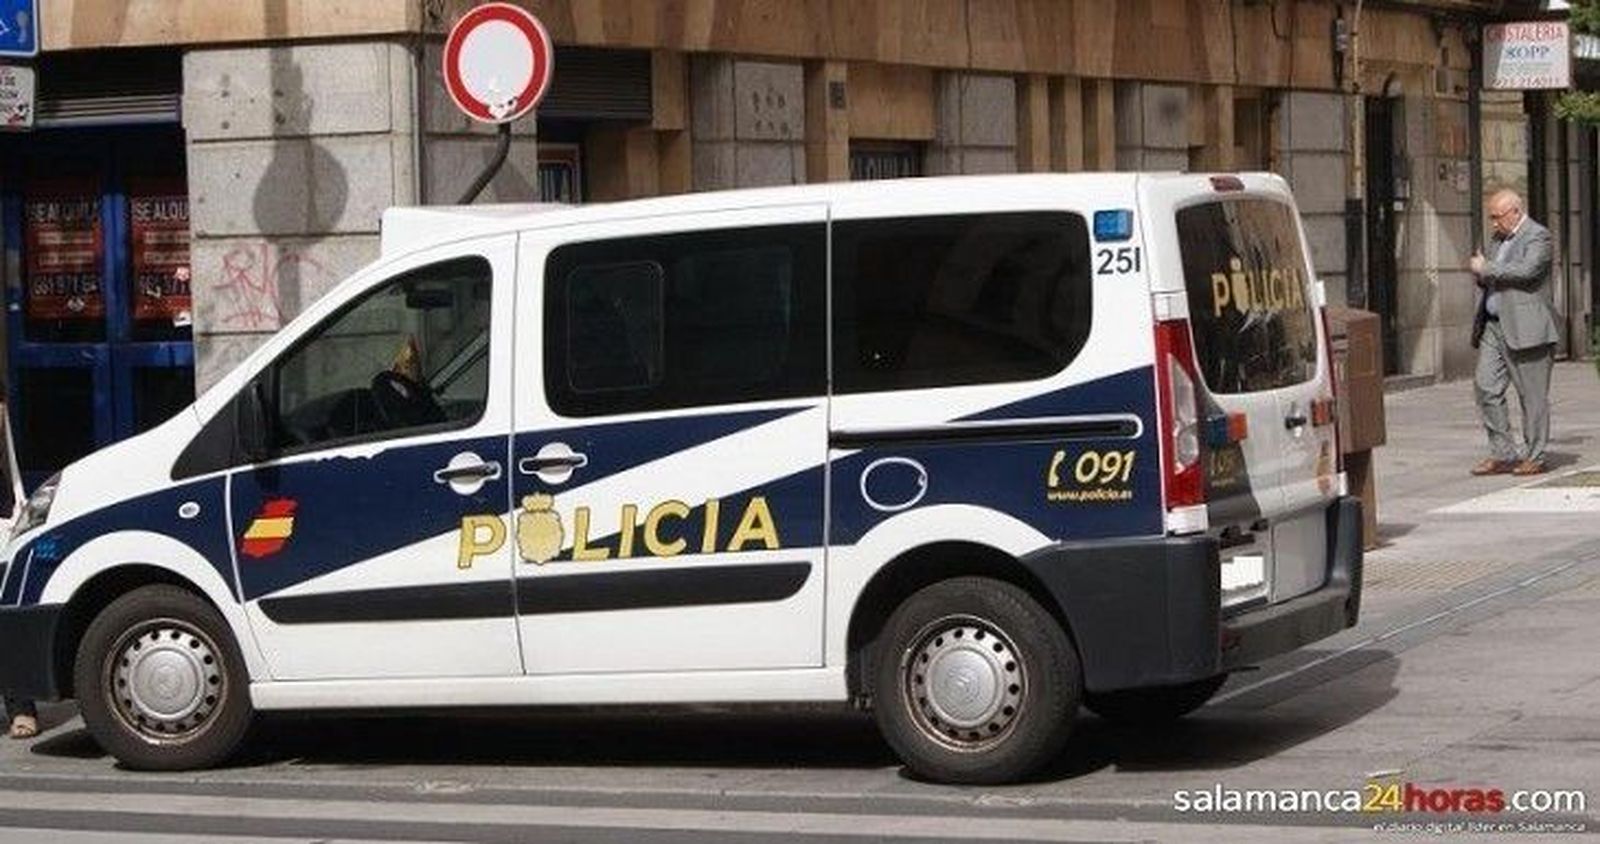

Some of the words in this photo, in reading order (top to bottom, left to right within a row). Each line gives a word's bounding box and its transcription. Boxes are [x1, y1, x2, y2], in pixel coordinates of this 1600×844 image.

[1211, 257, 1303, 317] POLICIA
[1075, 450, 1135, 484] 091
[457, 493, 781, 569] POLICIA
